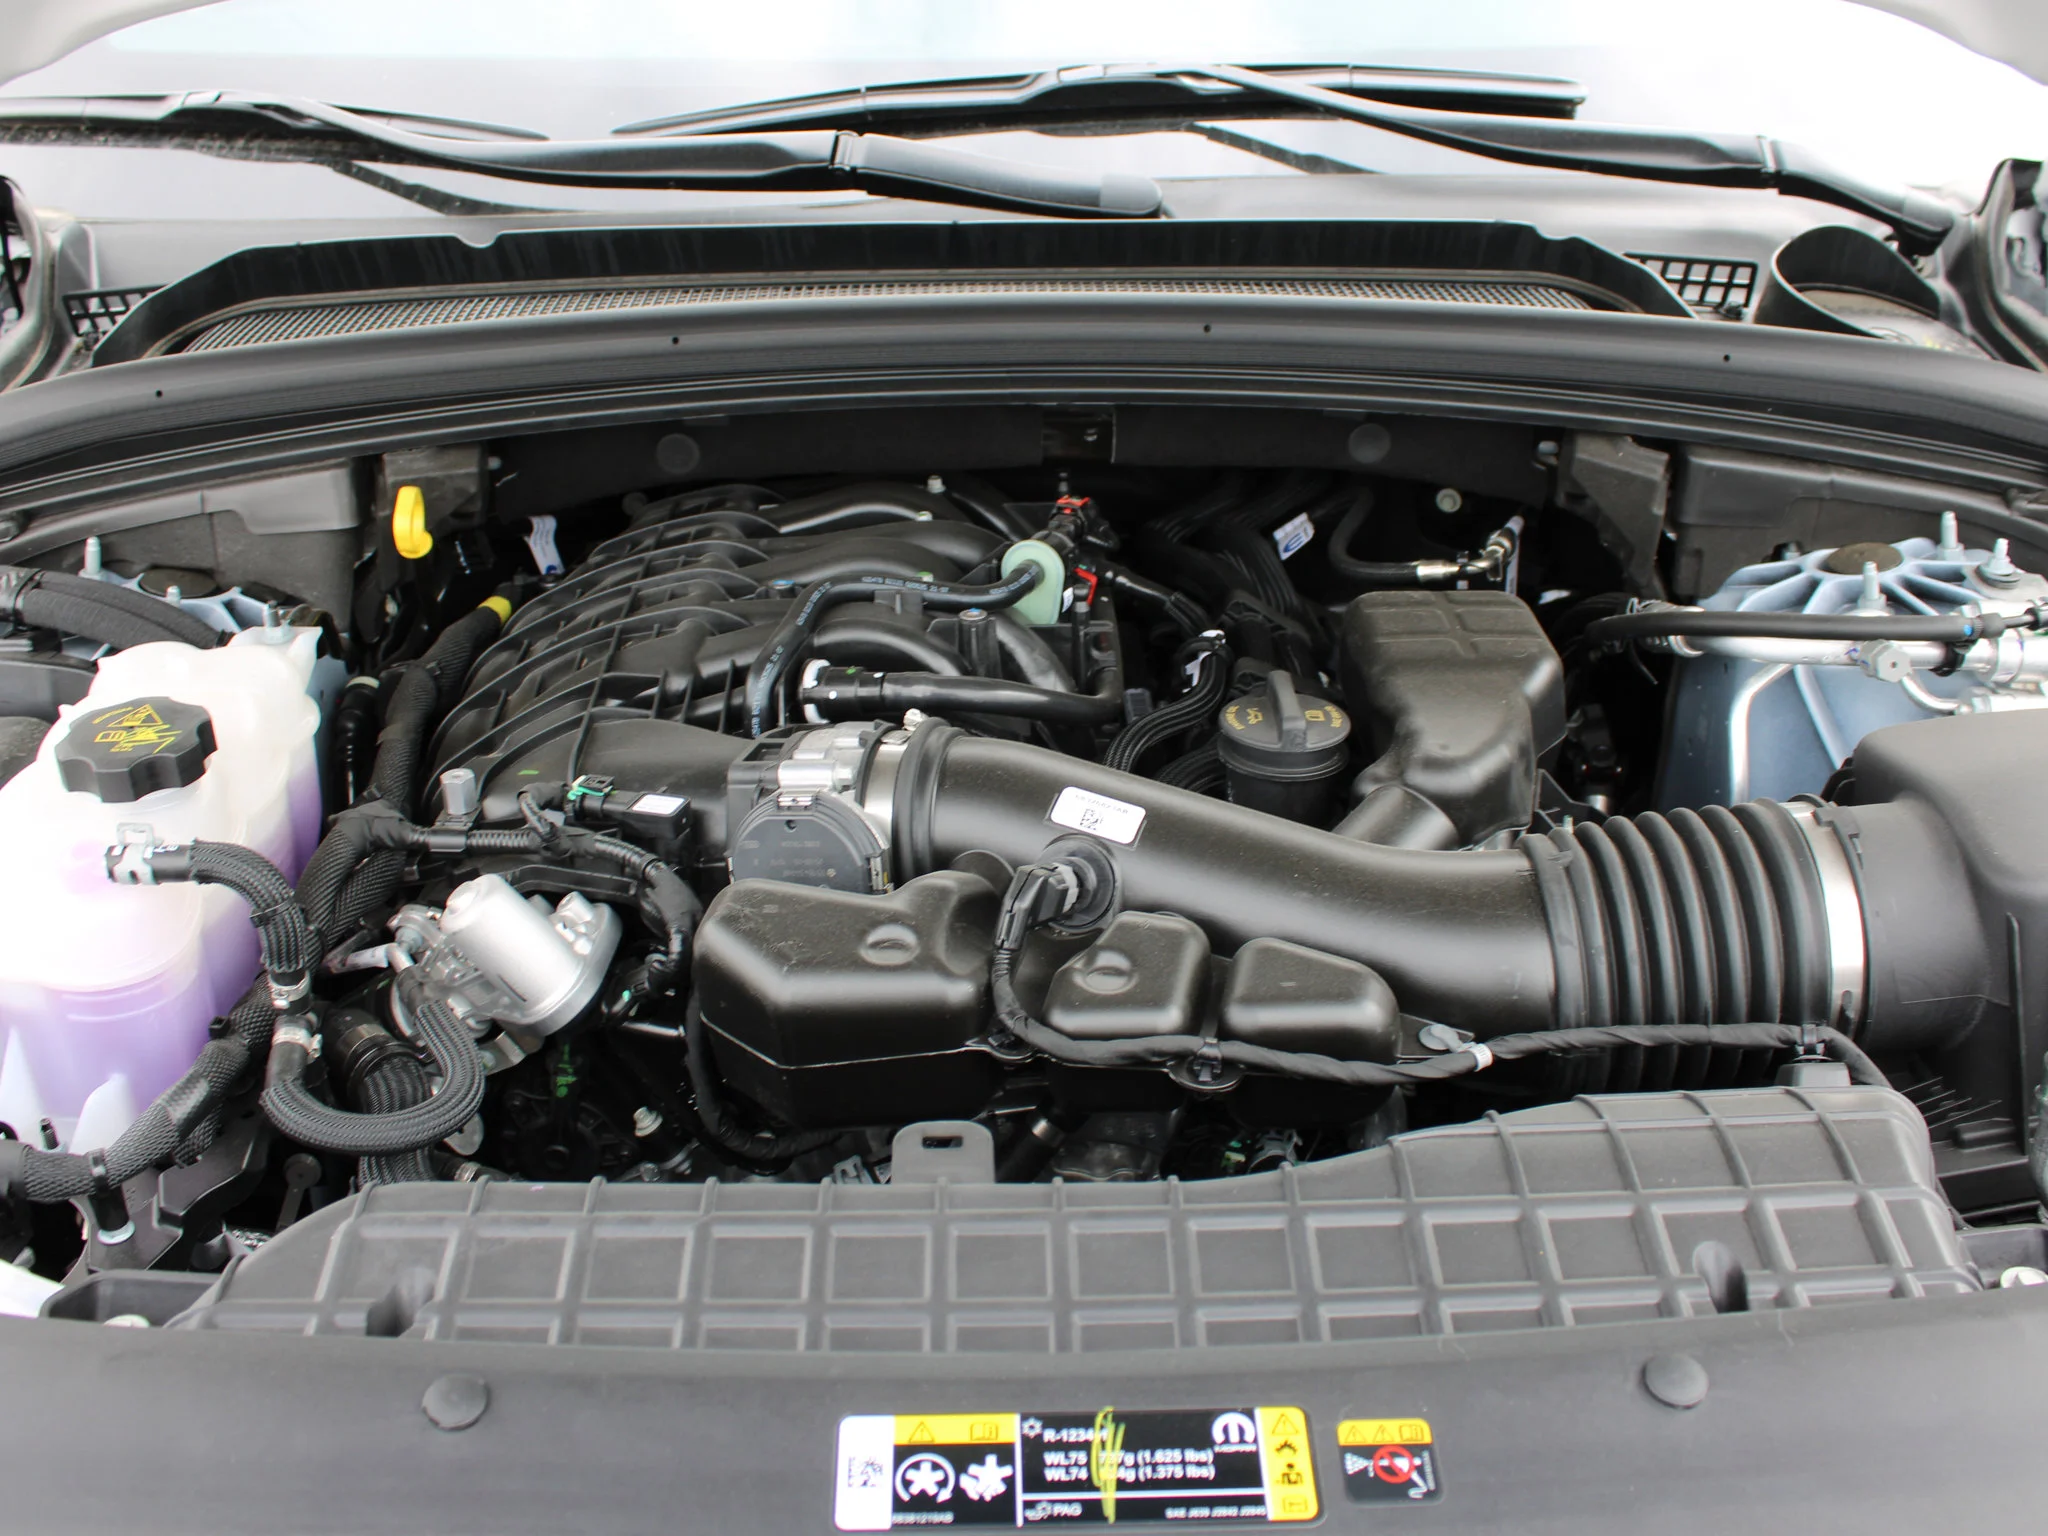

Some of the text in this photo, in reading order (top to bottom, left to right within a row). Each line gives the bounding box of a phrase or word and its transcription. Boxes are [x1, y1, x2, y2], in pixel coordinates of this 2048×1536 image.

[1043, 1450, 1088, 1466] WL75
[1136, 1449, 1183, 1466] (1.625
[1184, 1448, 1214, 1465] lbs)
[1043, 1463, 1215, 1483] WL74 4g (1.375 lbs)
[1052, 1502, 1083, 1517] PAG
